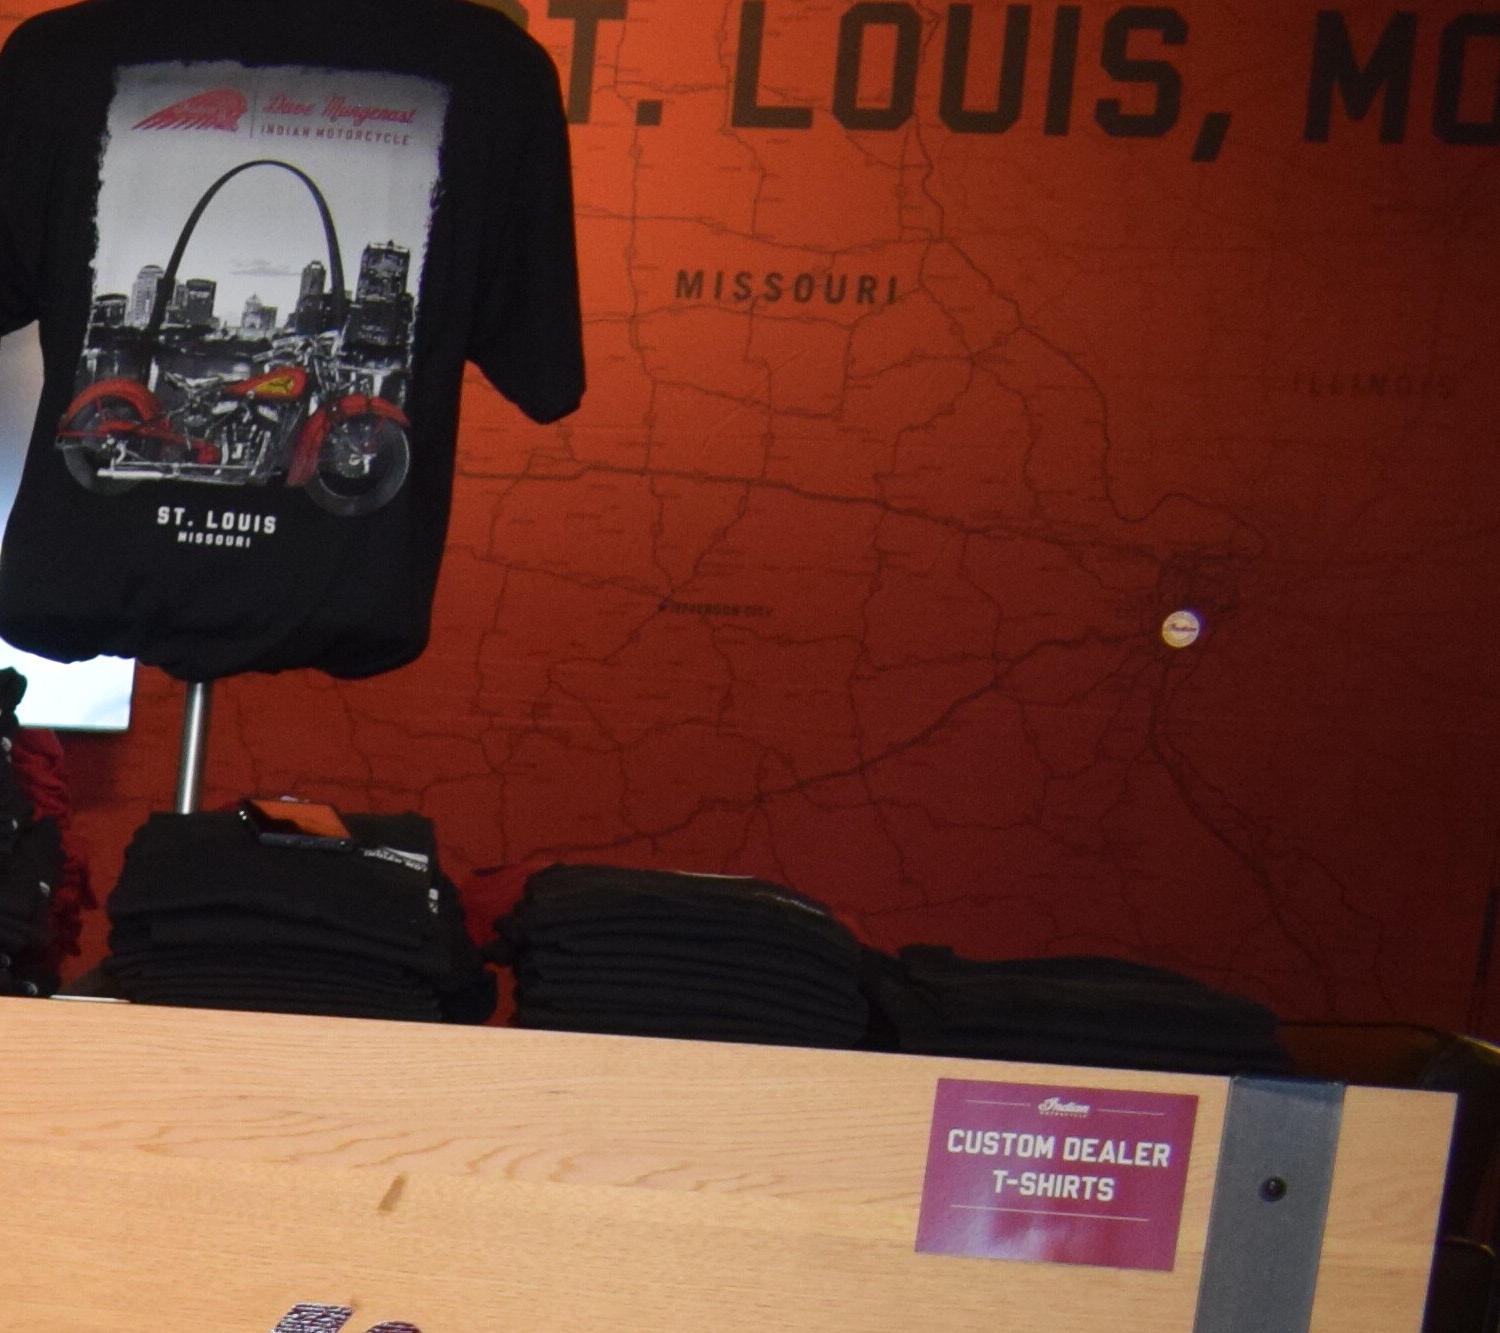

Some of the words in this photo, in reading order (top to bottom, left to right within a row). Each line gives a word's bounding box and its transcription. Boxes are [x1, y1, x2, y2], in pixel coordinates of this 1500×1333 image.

[490, 0, 664, 126] T.
[731, 0, 1232, 163] LOUIS,
[260, 124, 311, 138] INDIAN
[315, 127, 411, 145] MOTORCYCLE
[675, 269, 902, 306] MISSOURI
[156, 505, 196, 527] ST.
[206, 509, 278, 535] LOUIS
[177, 530, 252, 549] MISSOURI
[1037, 1097, 1091, 1115] Indian
[947, 1128, 1055, 1160] CUSTOM
[1062, 1136, 1171, 1168] DEALER
[992, 1169, 1115, 1202] T-SHIRTS
